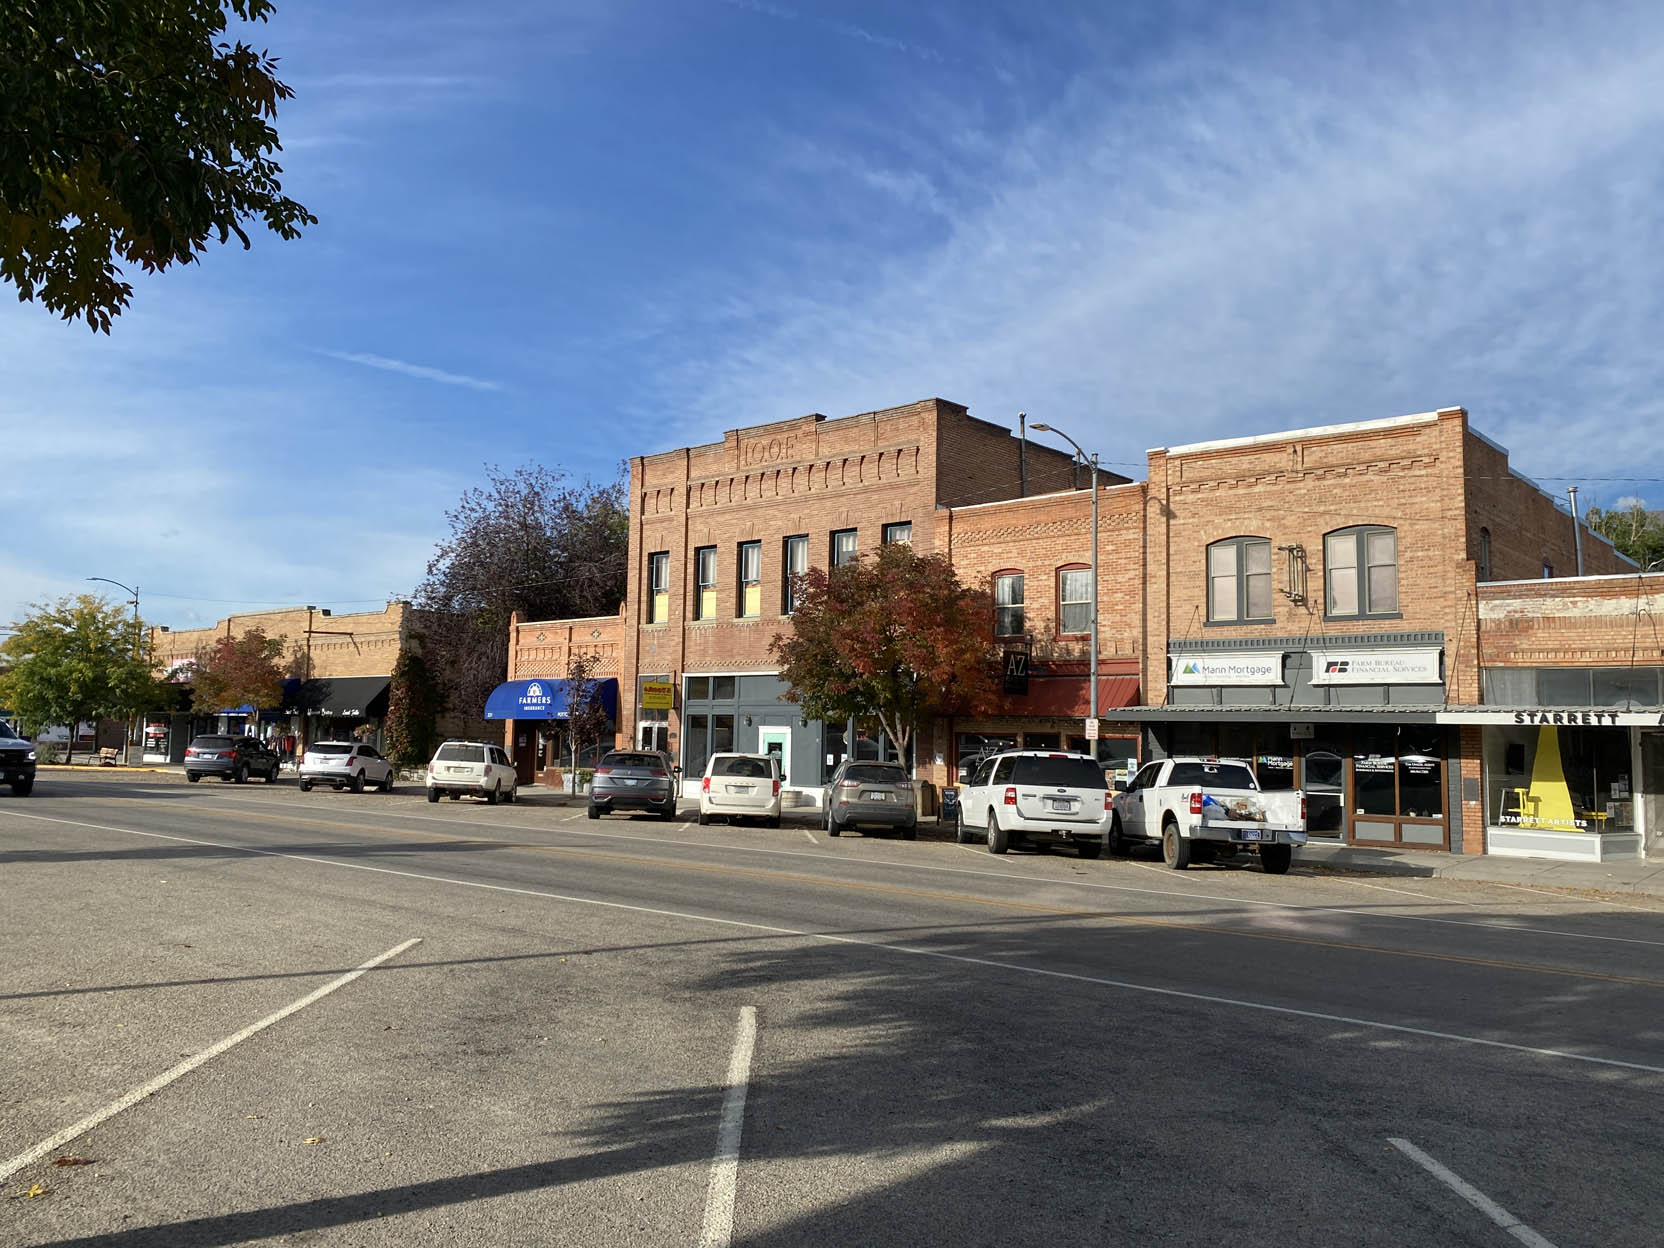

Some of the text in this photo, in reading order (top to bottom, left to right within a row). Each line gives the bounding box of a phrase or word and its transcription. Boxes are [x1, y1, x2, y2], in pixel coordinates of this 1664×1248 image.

[1007, 653, 1026, 676] AZ
[1202, 665, 1272, 676] Mann Mortgage
[1514, 711, 1619, 725] STARRETT
[1500, 815, 1588, 827] STARRETT ARTISTS
